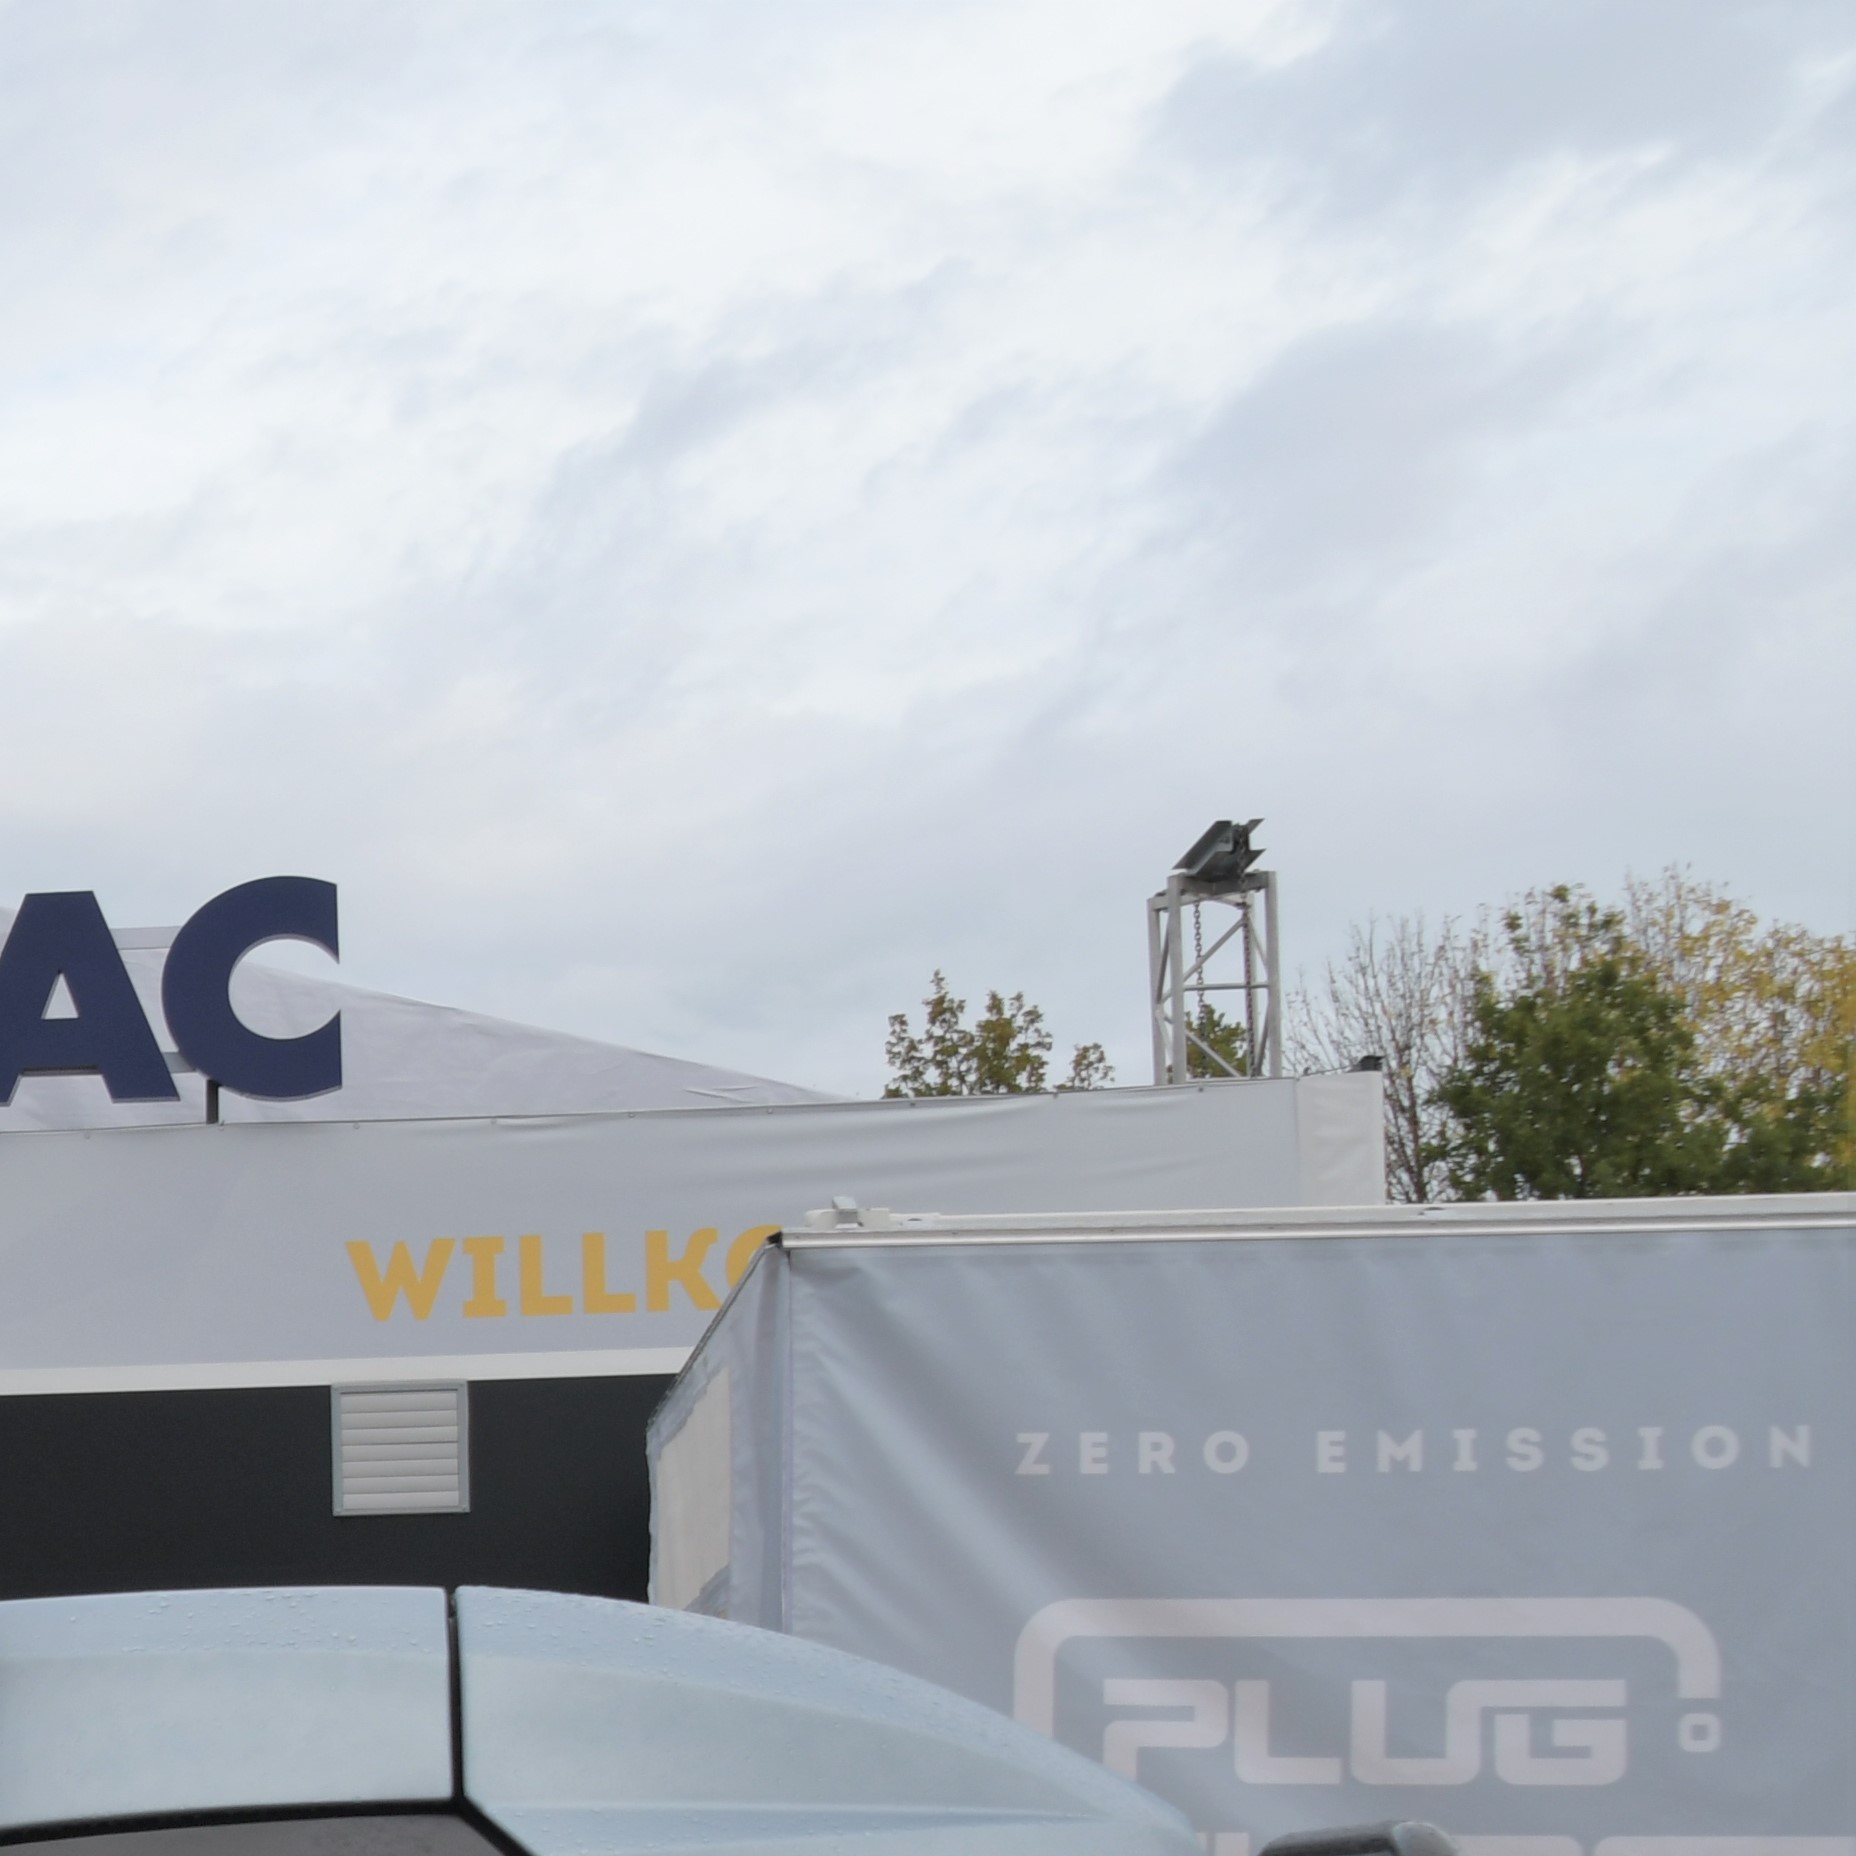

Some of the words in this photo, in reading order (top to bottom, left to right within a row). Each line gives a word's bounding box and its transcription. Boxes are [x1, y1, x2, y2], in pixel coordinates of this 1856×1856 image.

[1014, 1430, 1251, 1476] ZERO
[1315, 1425, 1812, 1474] EMISSION
[1102, 1679, 1627, 1786] PLUG
